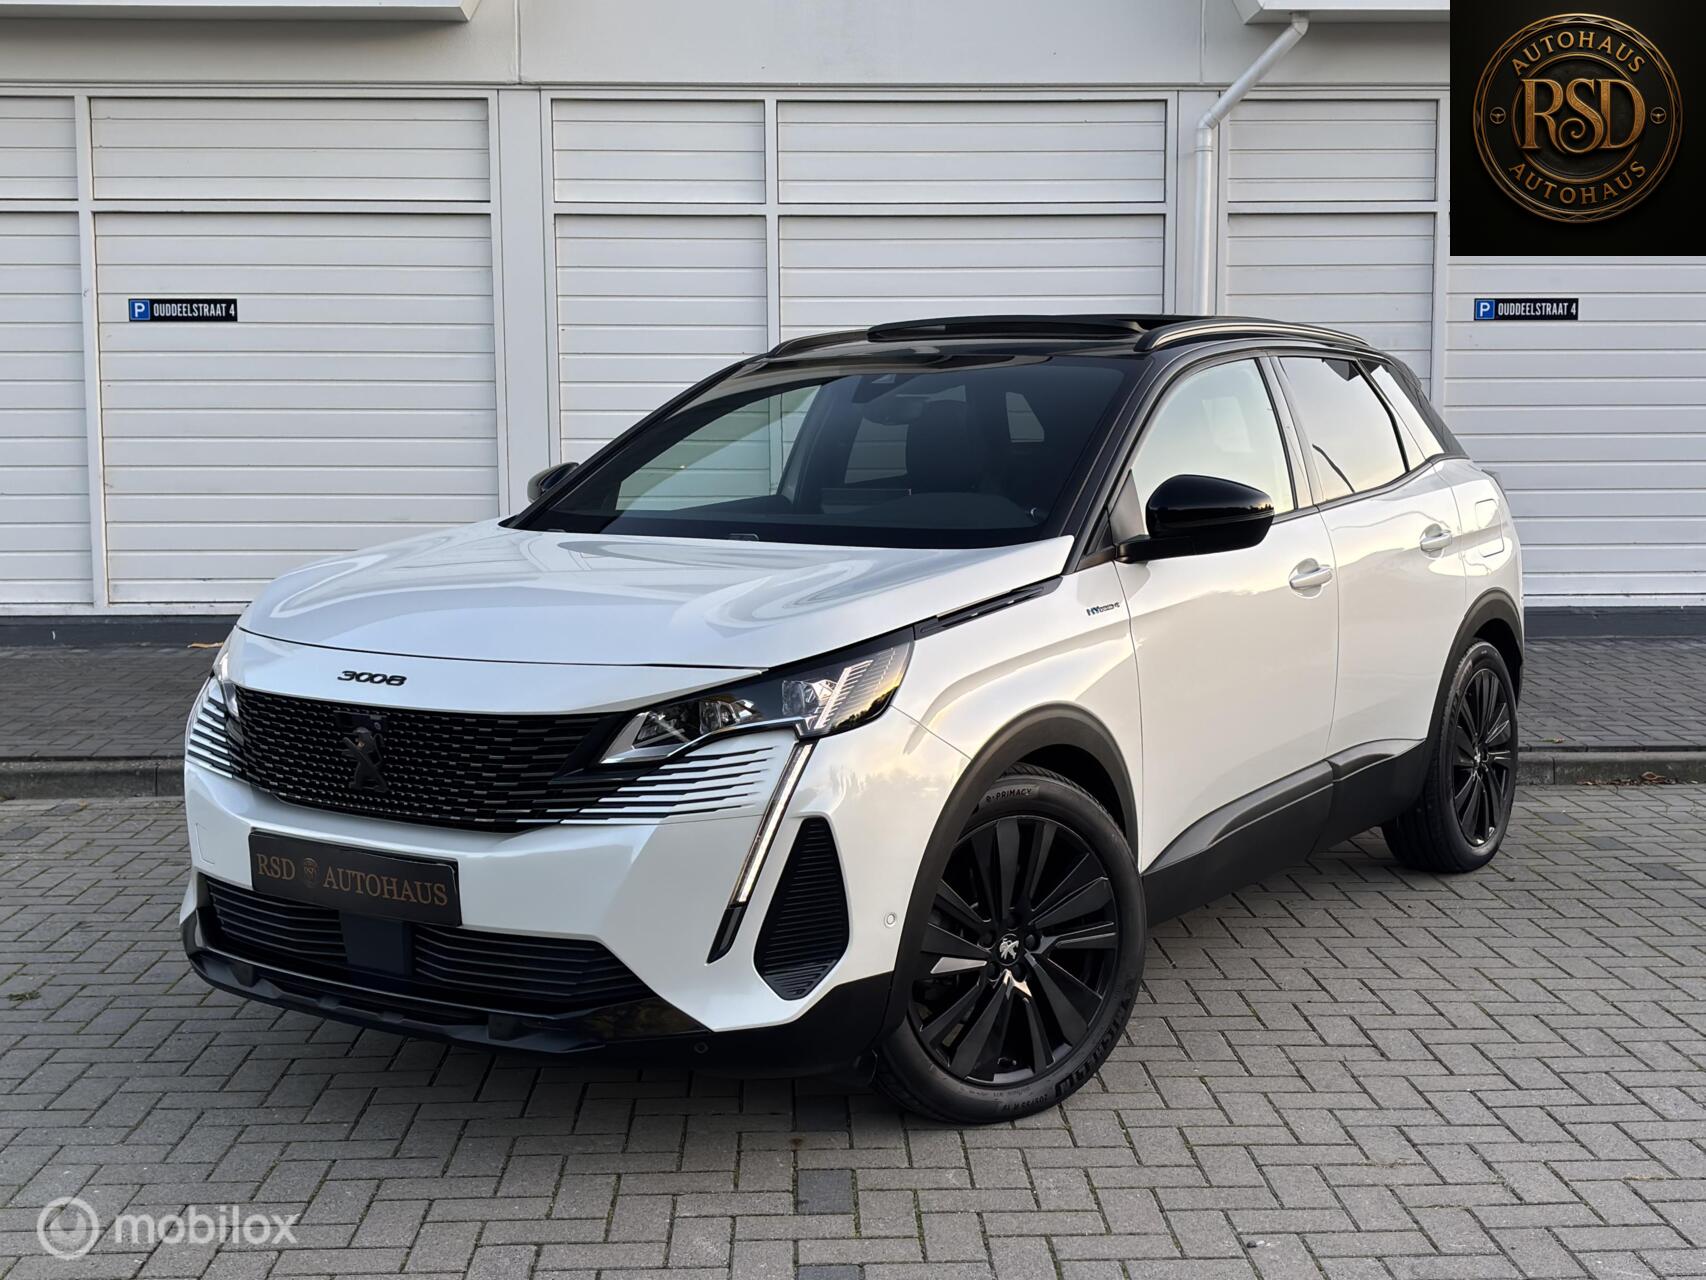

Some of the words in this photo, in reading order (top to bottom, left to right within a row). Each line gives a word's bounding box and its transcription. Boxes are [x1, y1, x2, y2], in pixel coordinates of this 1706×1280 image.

[134, 302, 145, 318] P
[153, 303, 227, 317] OUDDEELSTRAAT
[229, 303, 235, 317] 4
[1480, 302, 1491, 317] P
[1498, 302, 1568, 316] OUDDEELSTRAAT
[1571, 302, 1576, 316] 4
[337, 670, 407, 686] 3008
[256, 853, 296, 881] RSD
[323, 866, 448, 906] AUTOHAUS
